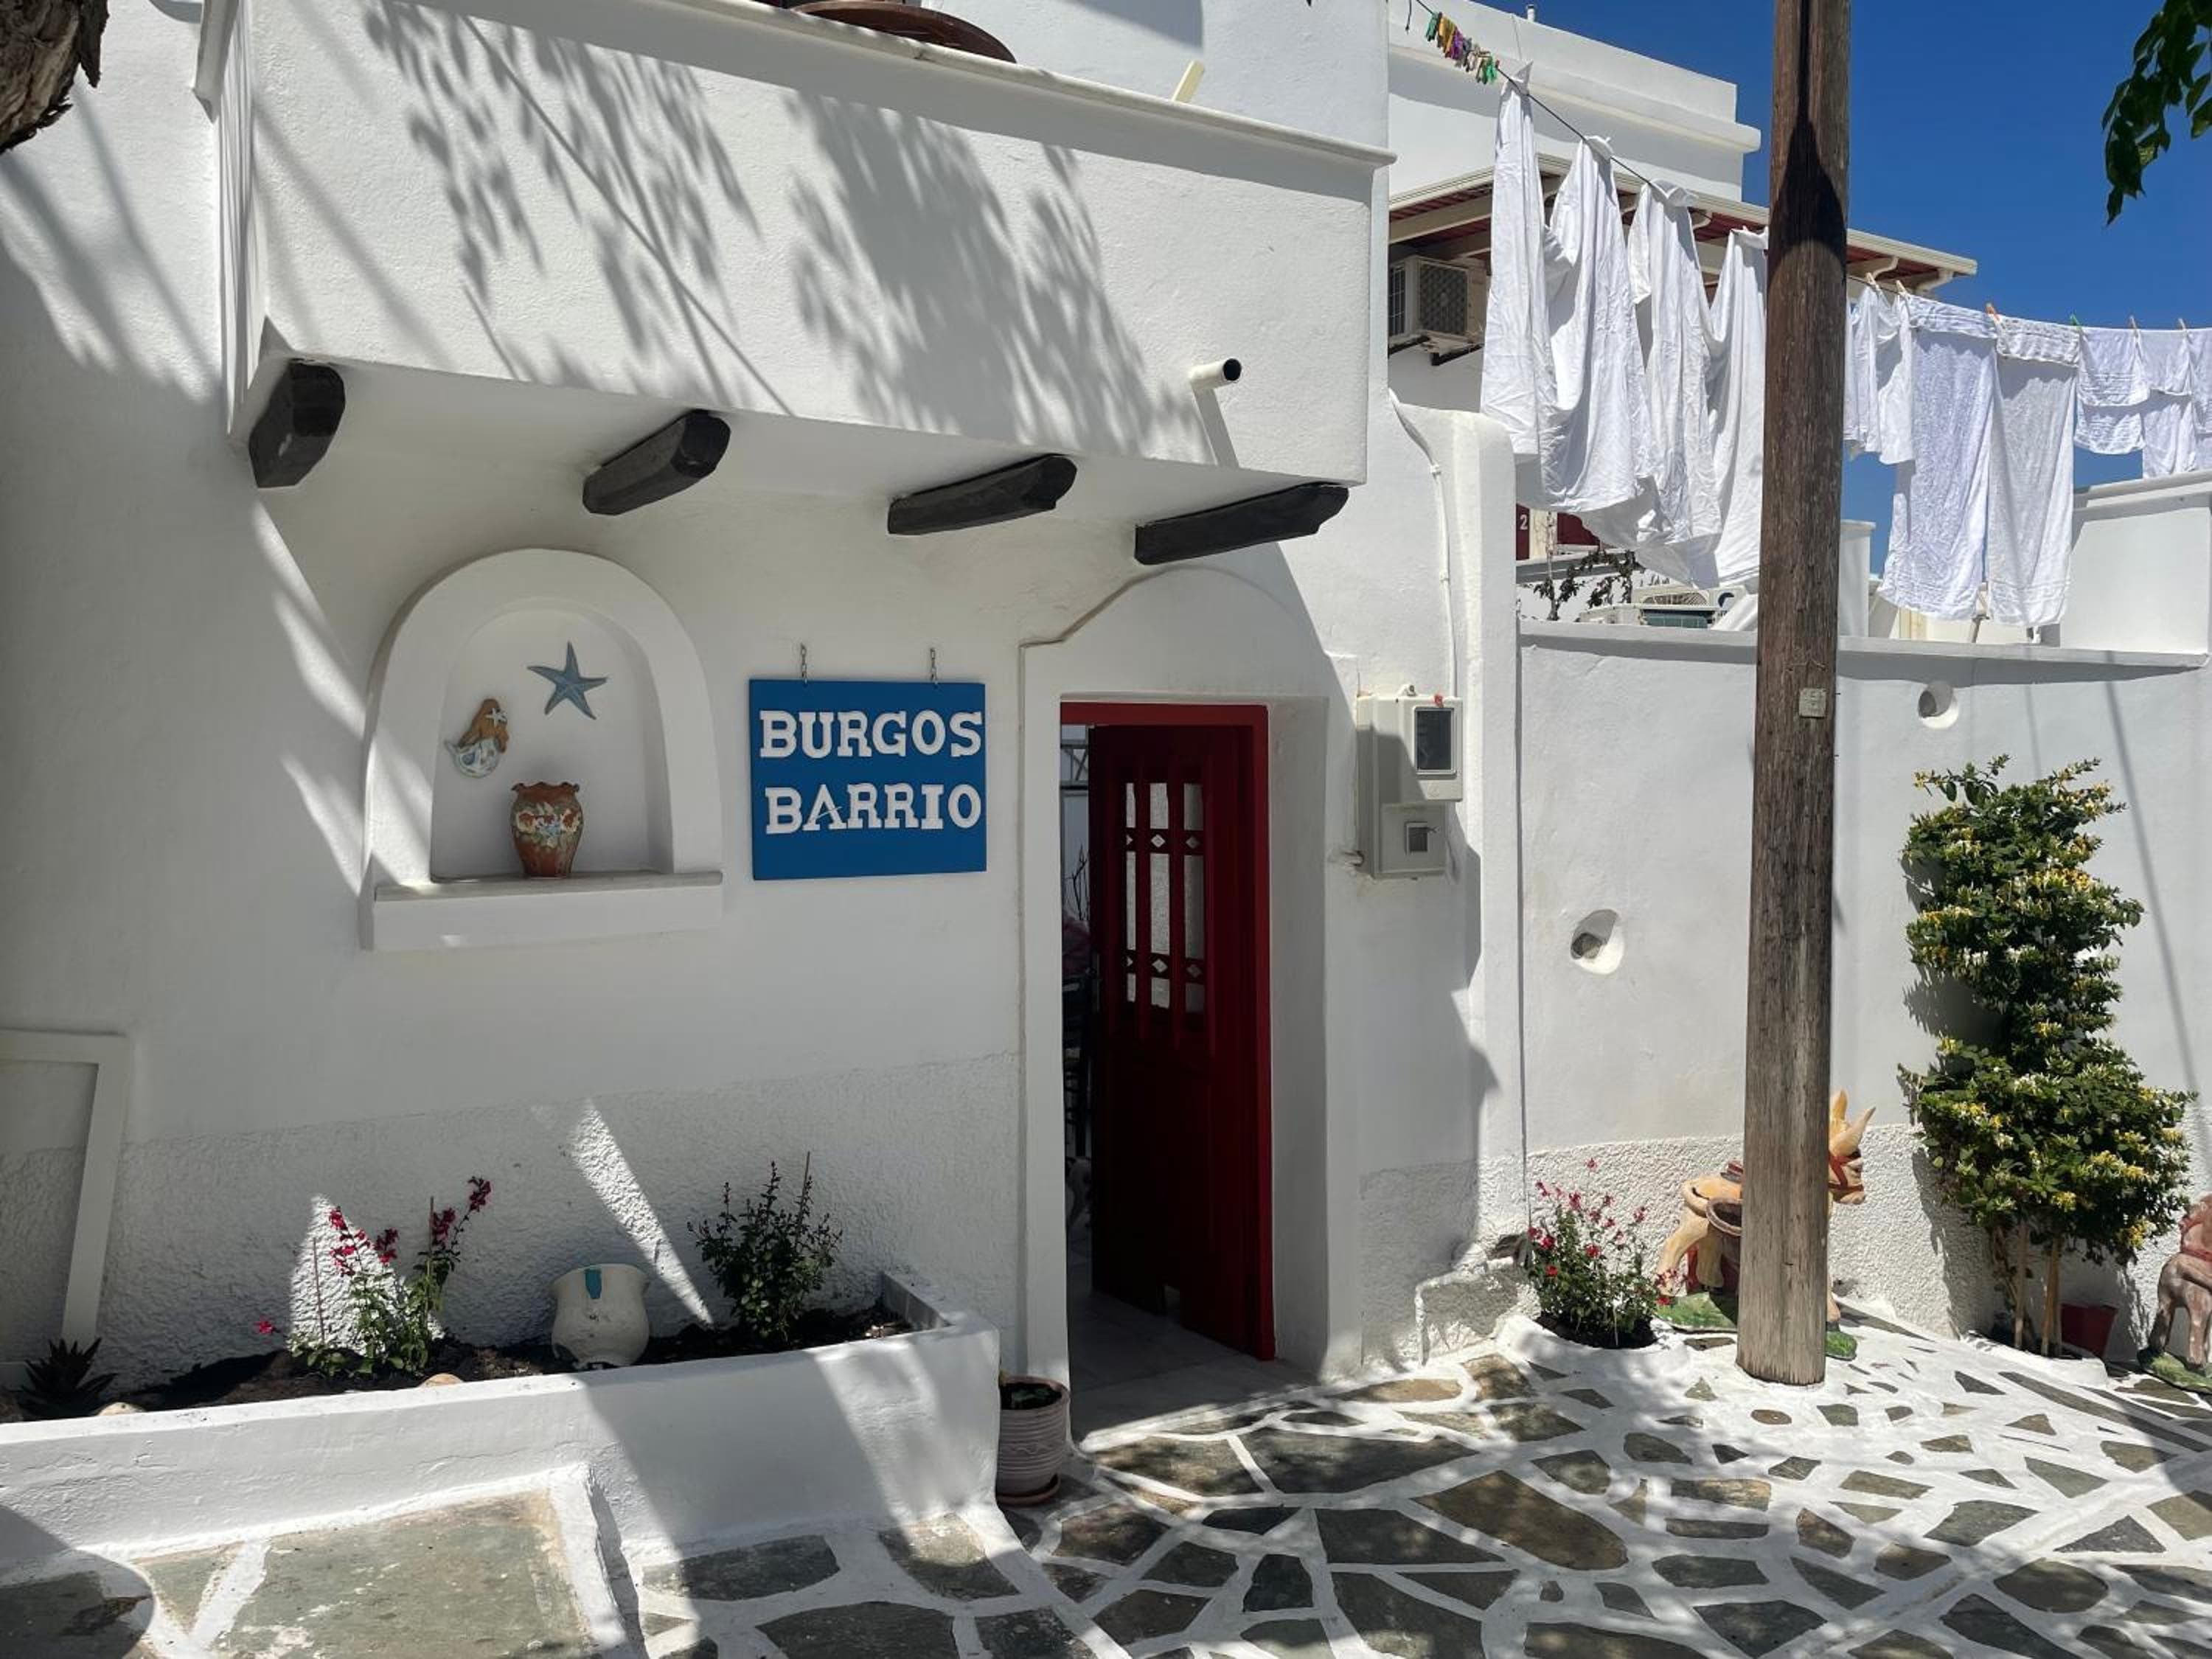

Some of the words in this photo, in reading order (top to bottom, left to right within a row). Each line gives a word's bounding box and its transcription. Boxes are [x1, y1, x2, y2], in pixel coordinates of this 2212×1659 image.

[1520, 515, 1528, 530] 2
[759, 710, 982, 759] BURGOS
[765, 782, 981, 835] BARRIO
